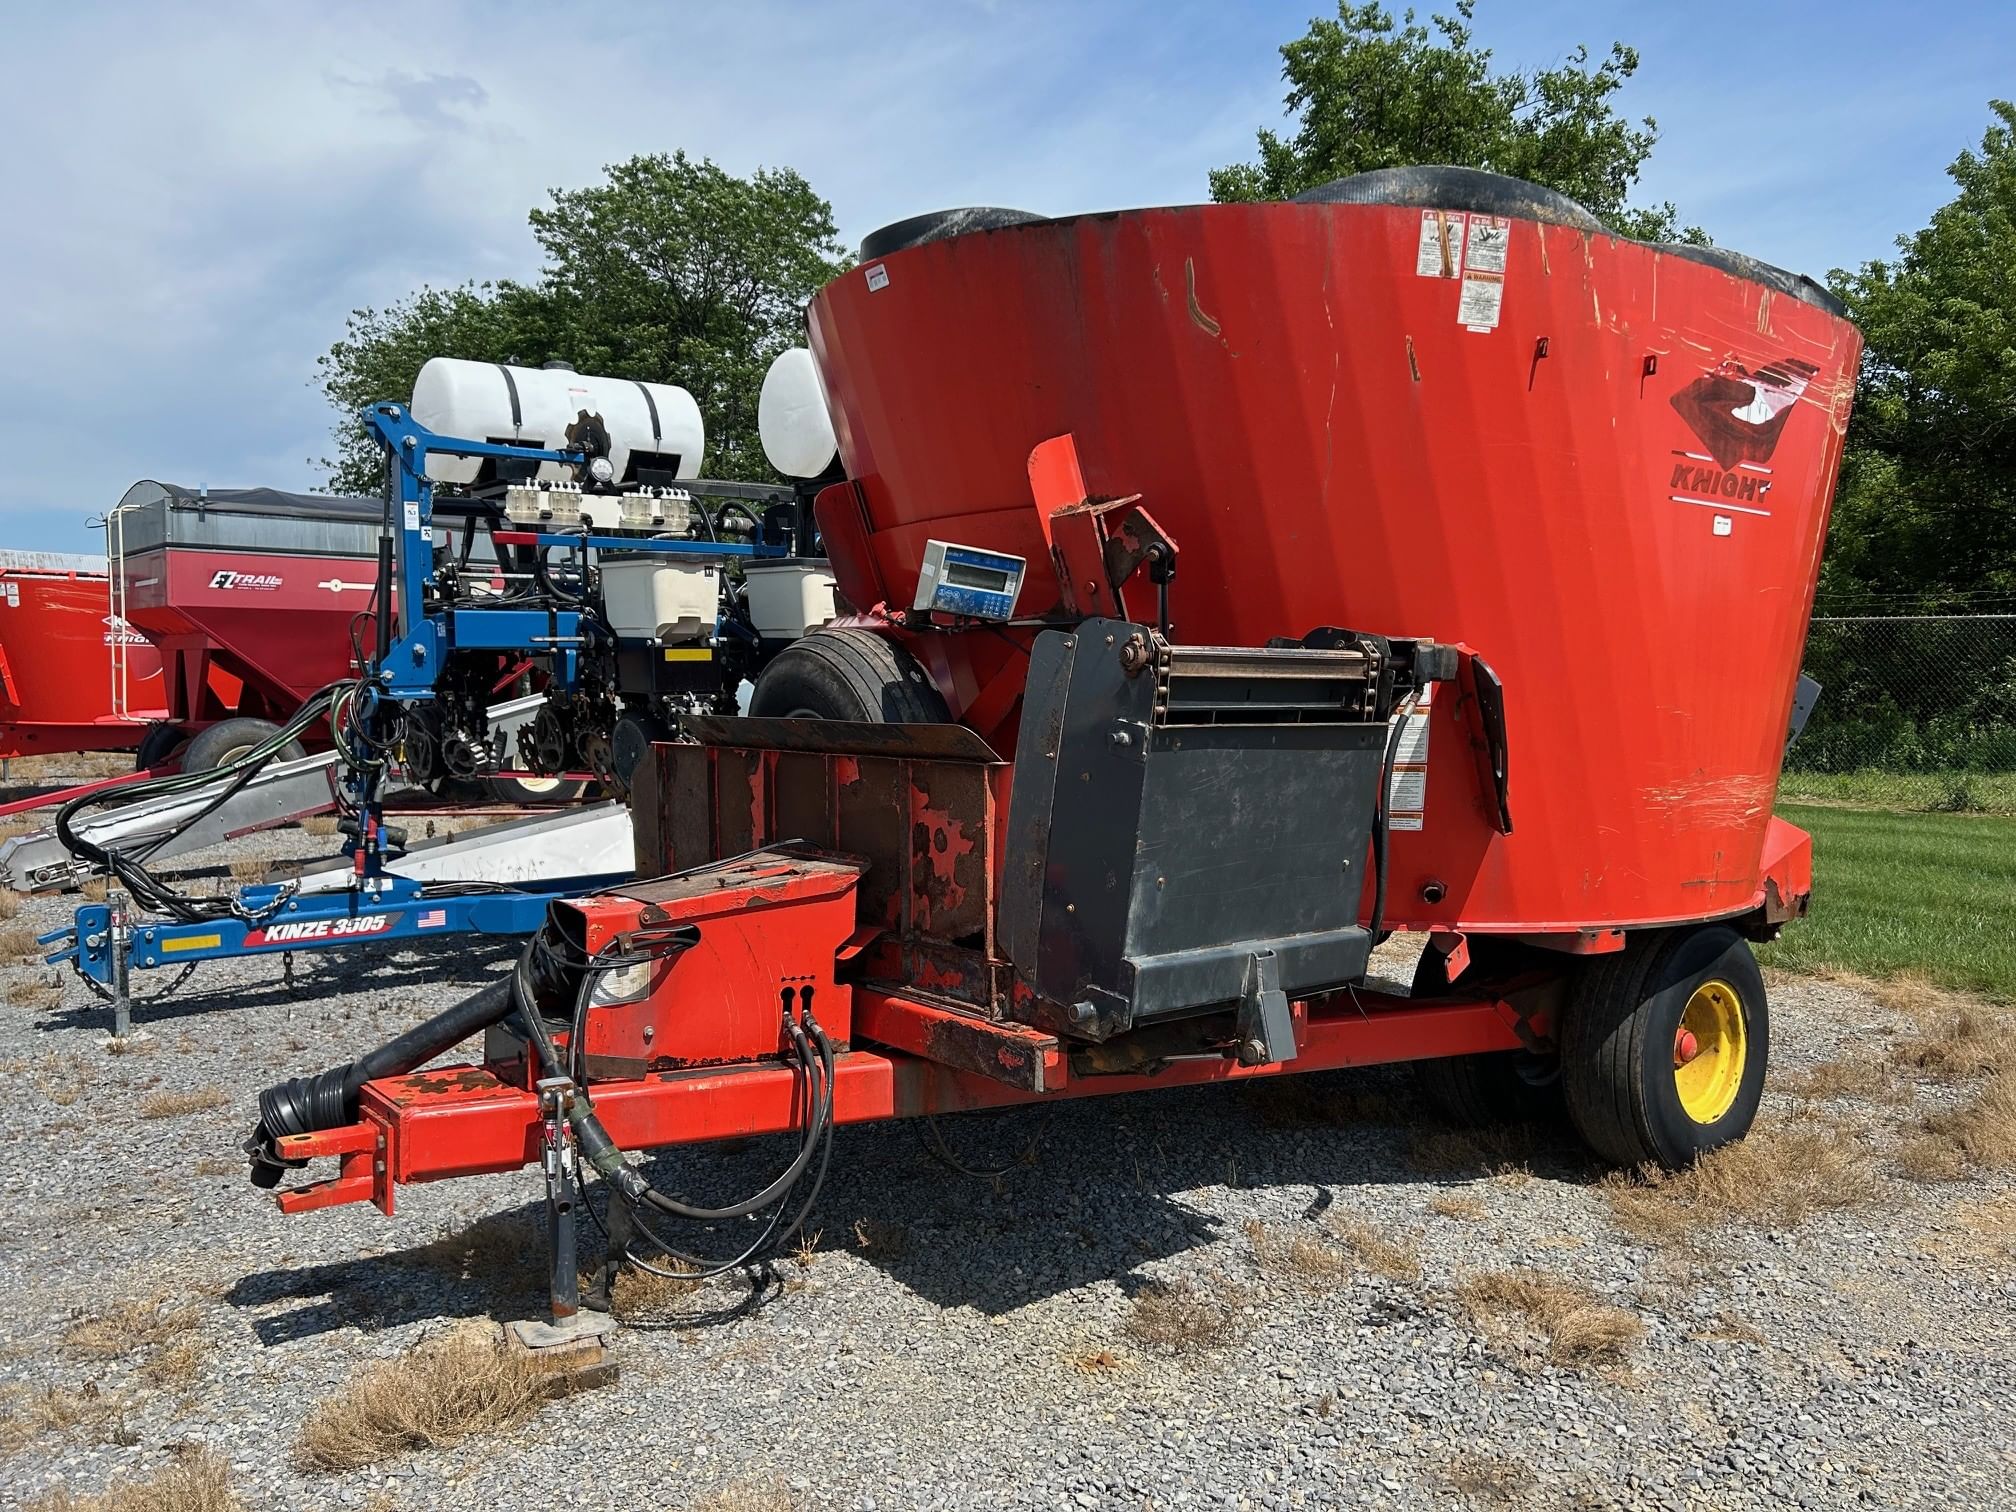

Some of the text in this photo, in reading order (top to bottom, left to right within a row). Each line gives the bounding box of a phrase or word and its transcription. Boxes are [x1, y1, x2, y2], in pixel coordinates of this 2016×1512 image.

[1669, 463, 1771, 504] KNIGHT
[104, 635, 150, 643] KNIG
[264, 914, 387, 942] KINZE 3505
